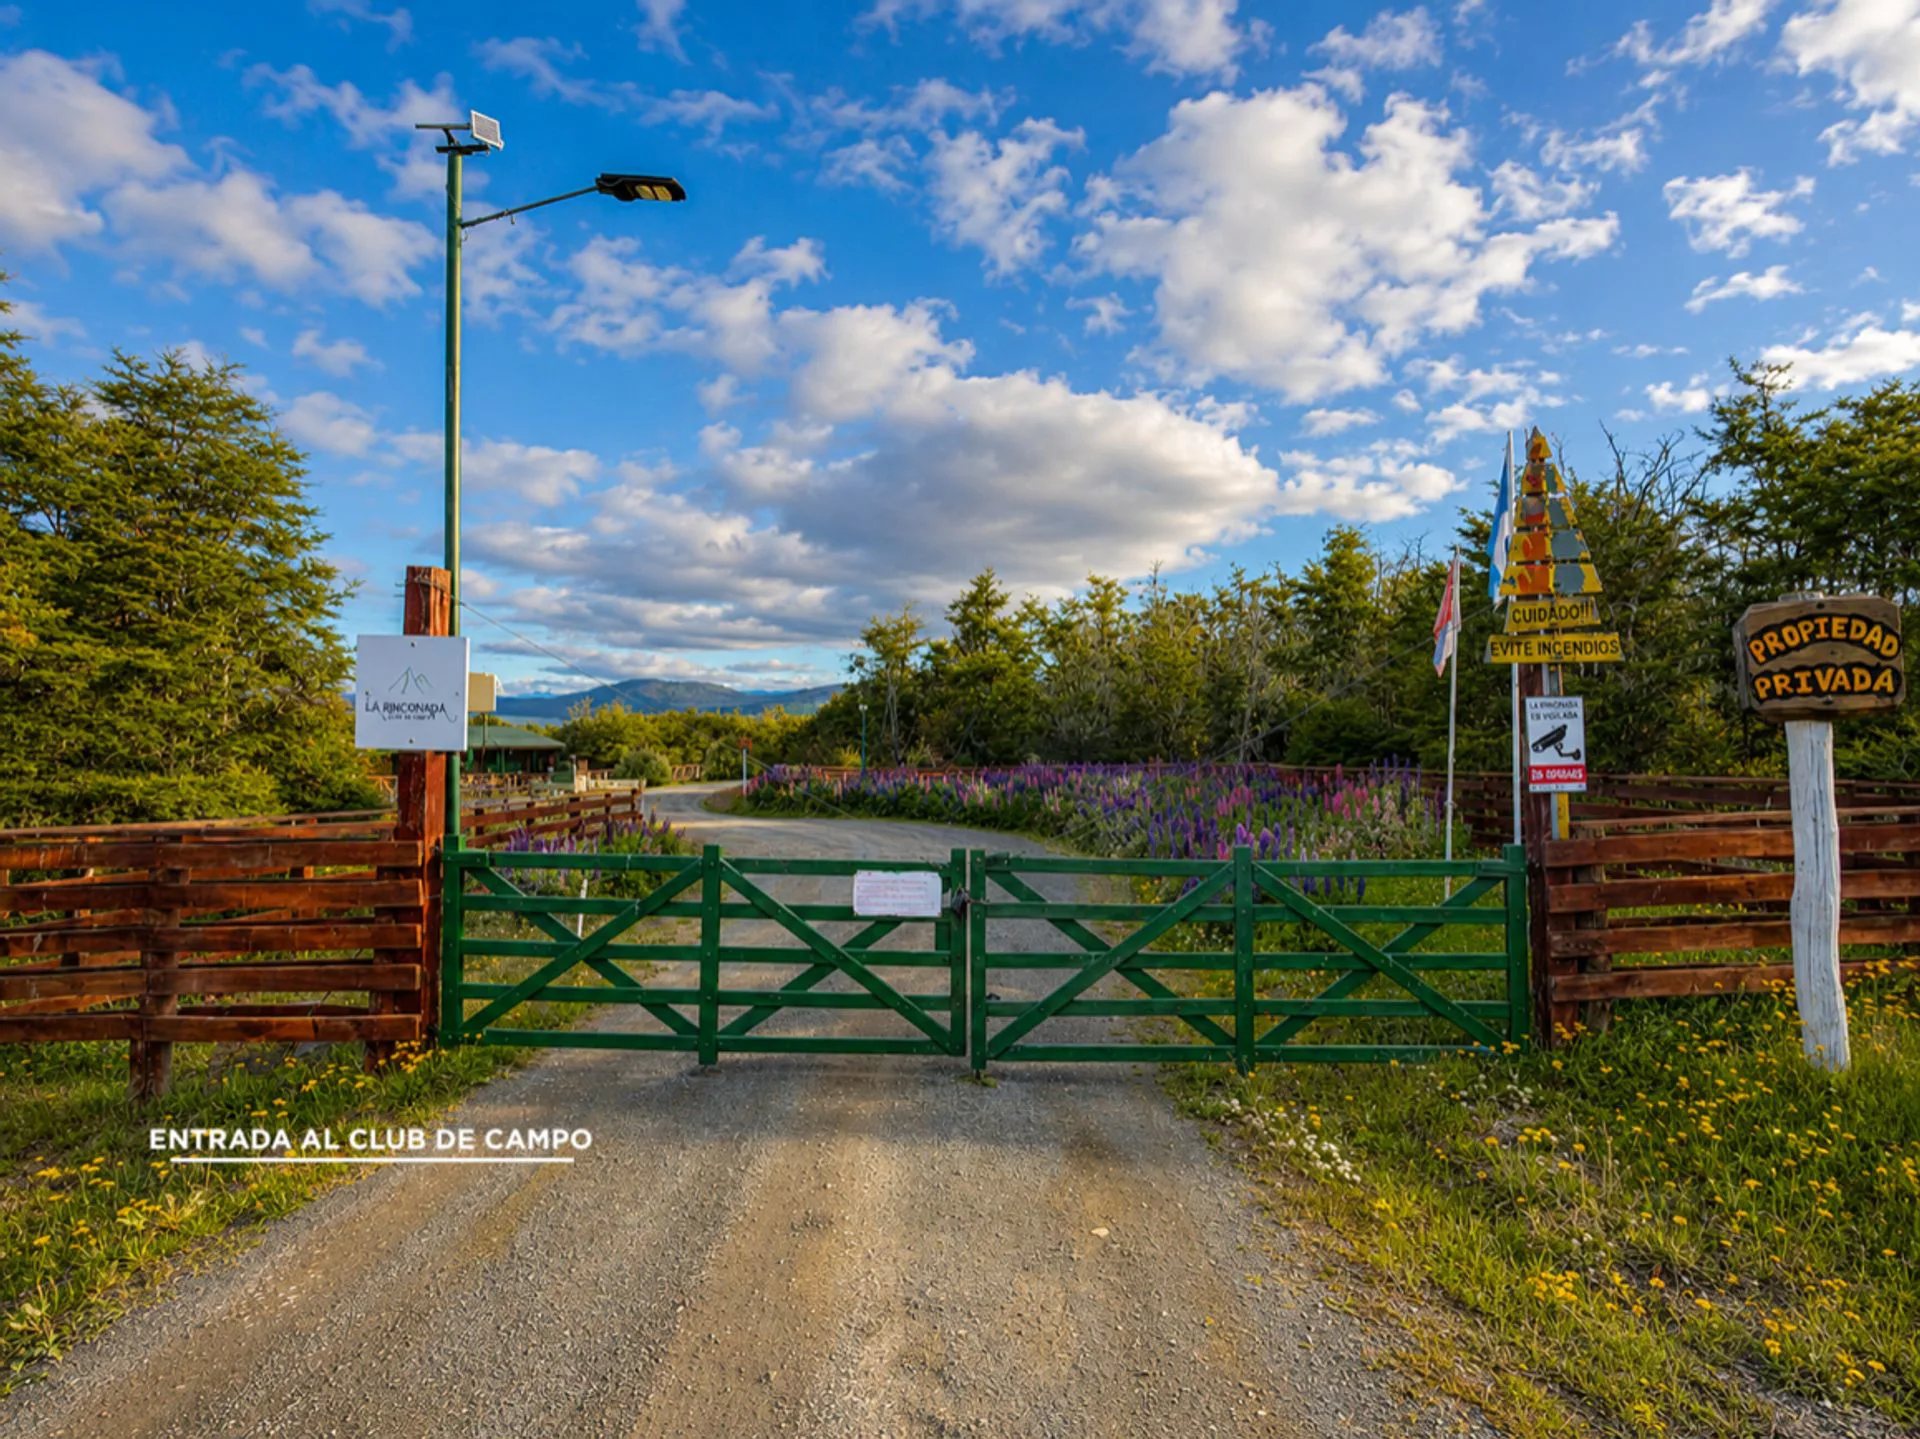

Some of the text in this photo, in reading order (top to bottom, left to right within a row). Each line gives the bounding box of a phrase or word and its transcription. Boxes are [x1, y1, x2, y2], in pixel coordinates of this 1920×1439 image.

[1489, 638, 1621, 658] EVITE INCENDIOS
[1749, 617, 1900, 664] PROPIEDAD
[1754, 667, 1895, 700] PRIVADA
[382, 701, 451, 716] RINCONADA
